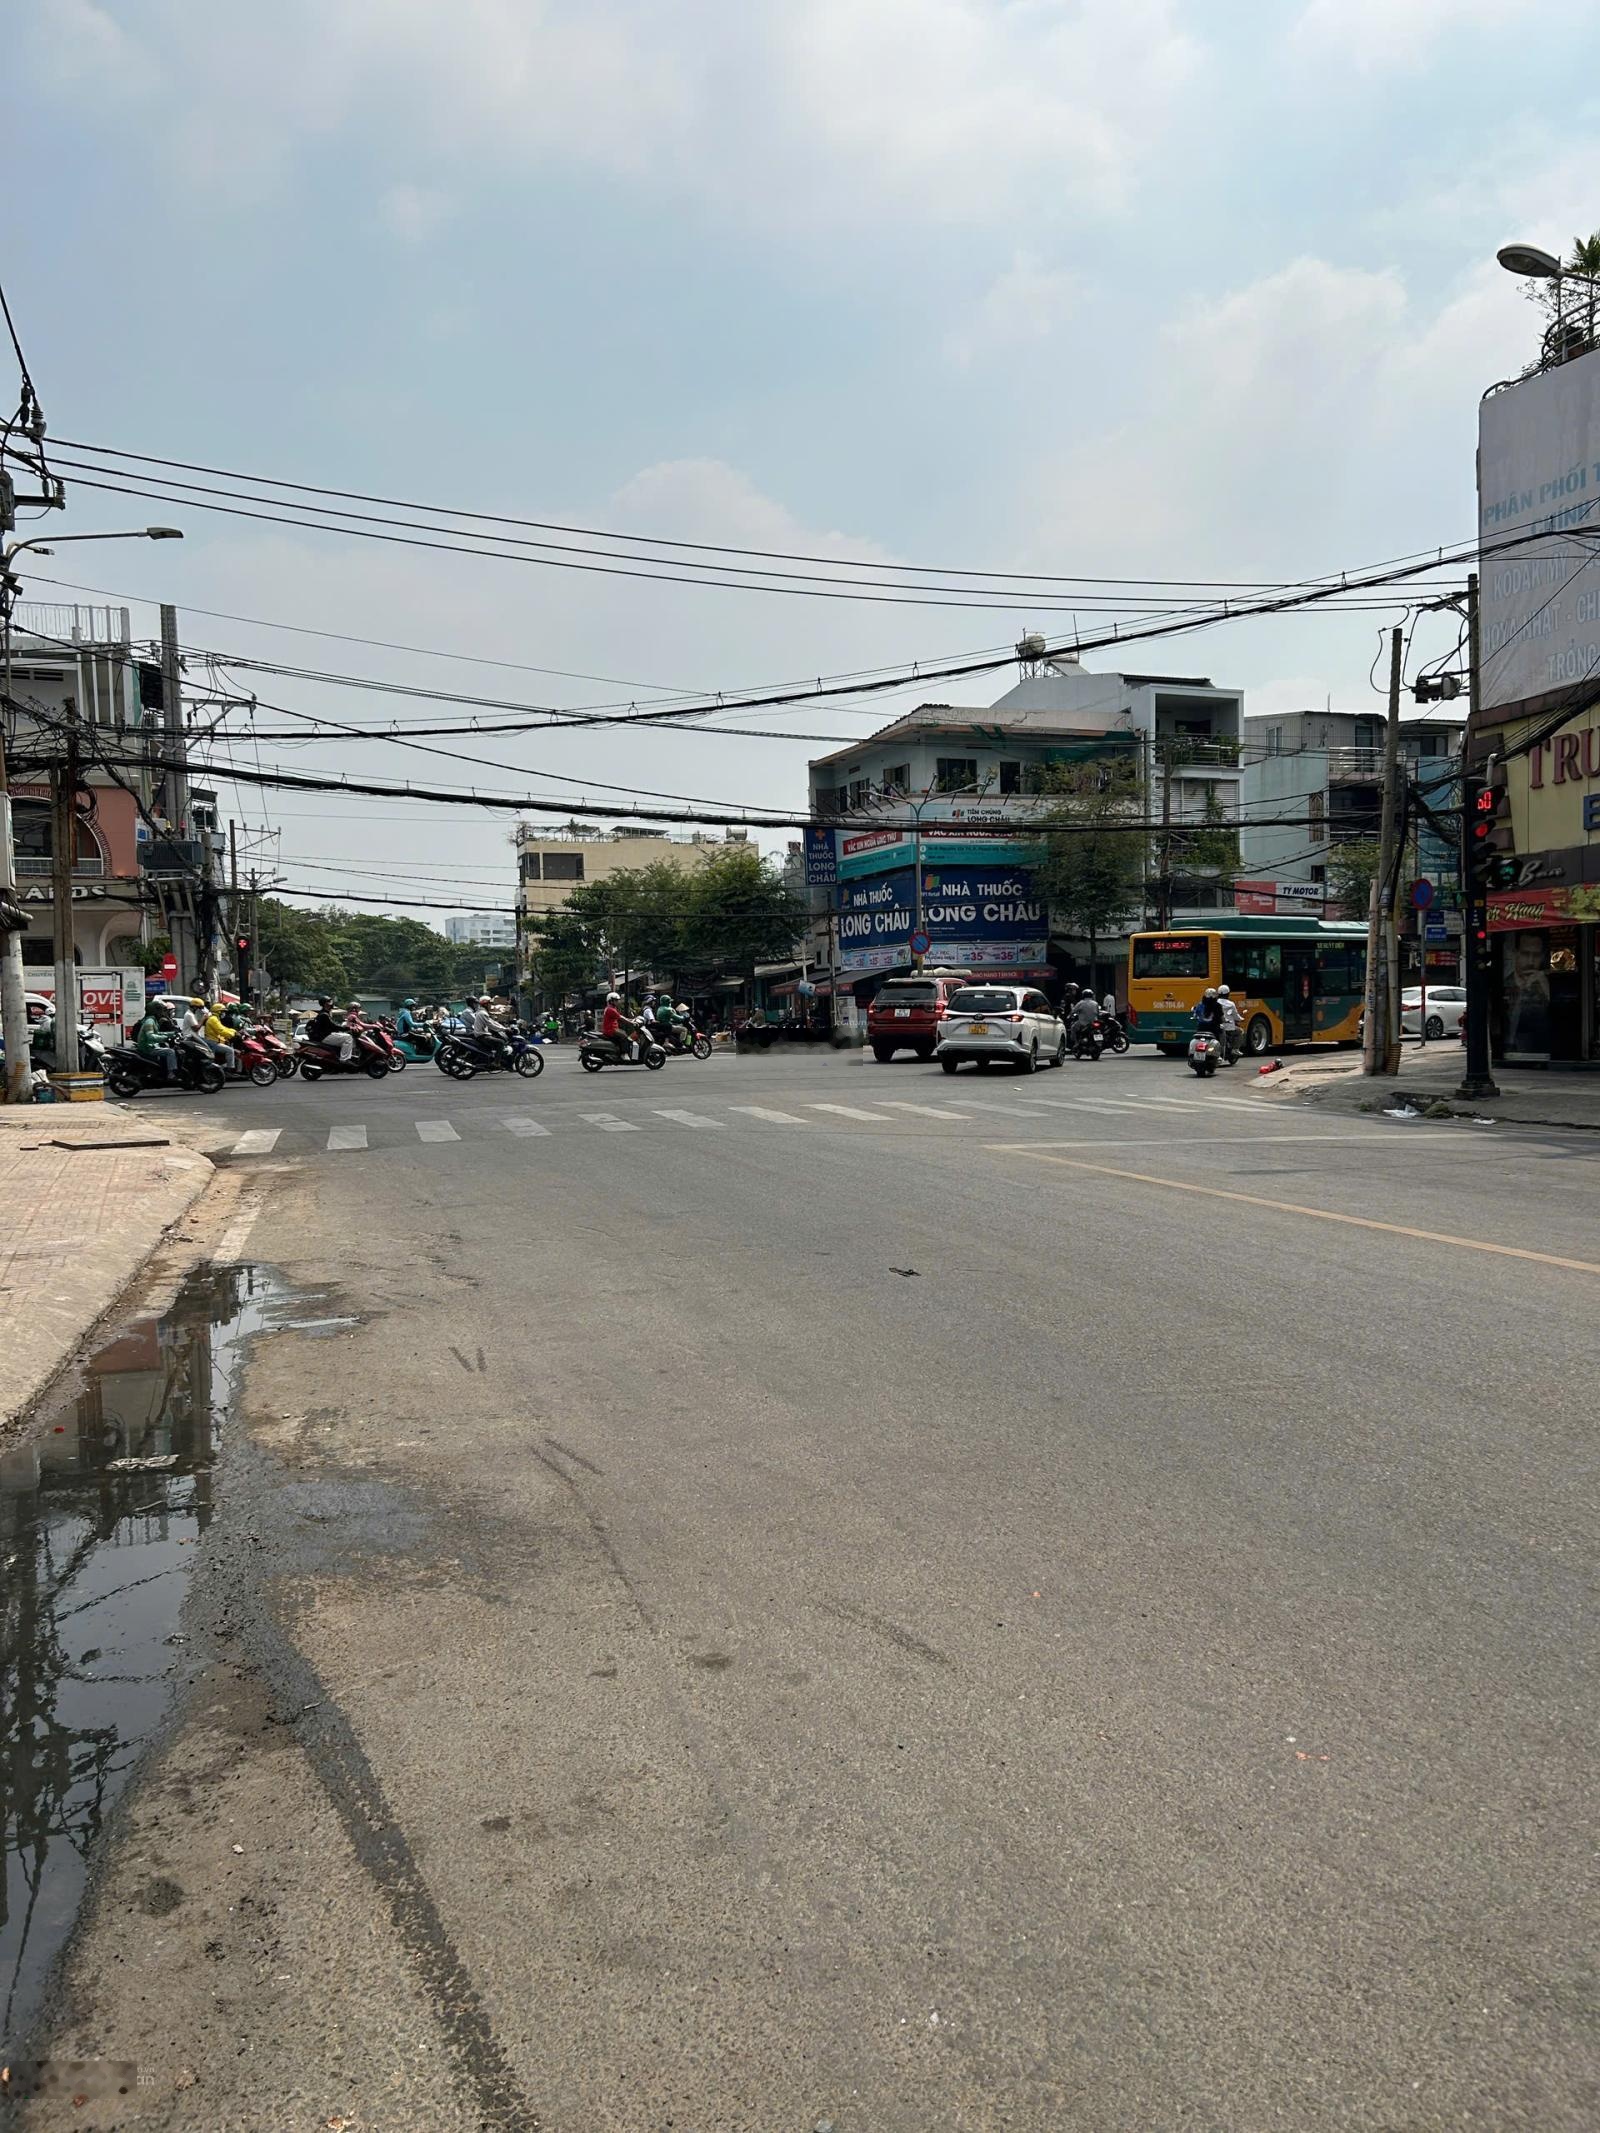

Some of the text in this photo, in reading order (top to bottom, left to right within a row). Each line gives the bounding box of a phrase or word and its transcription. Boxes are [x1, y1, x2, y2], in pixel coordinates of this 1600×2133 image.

[1483, 489, 1533, 527] PHÂN
[1540, 462, 1587, 504] PHỐI
[1493, 557, 1542, 601] KODAK
[1530, 726, 1600, 790] TRU
[808, 862, 835, 872] LONG
[808, 871, 836, 883] CHÂU
[853, 882, 893, 907] NHÀ THUỐC
[942, 879, 1023, 896] NHÀ THUỐC
[1293, 887, 1318, 895] MOTOR
[841, 903, 910, 938] LONG CHÂU
[983, 901, 1041, 922] CHÂU
